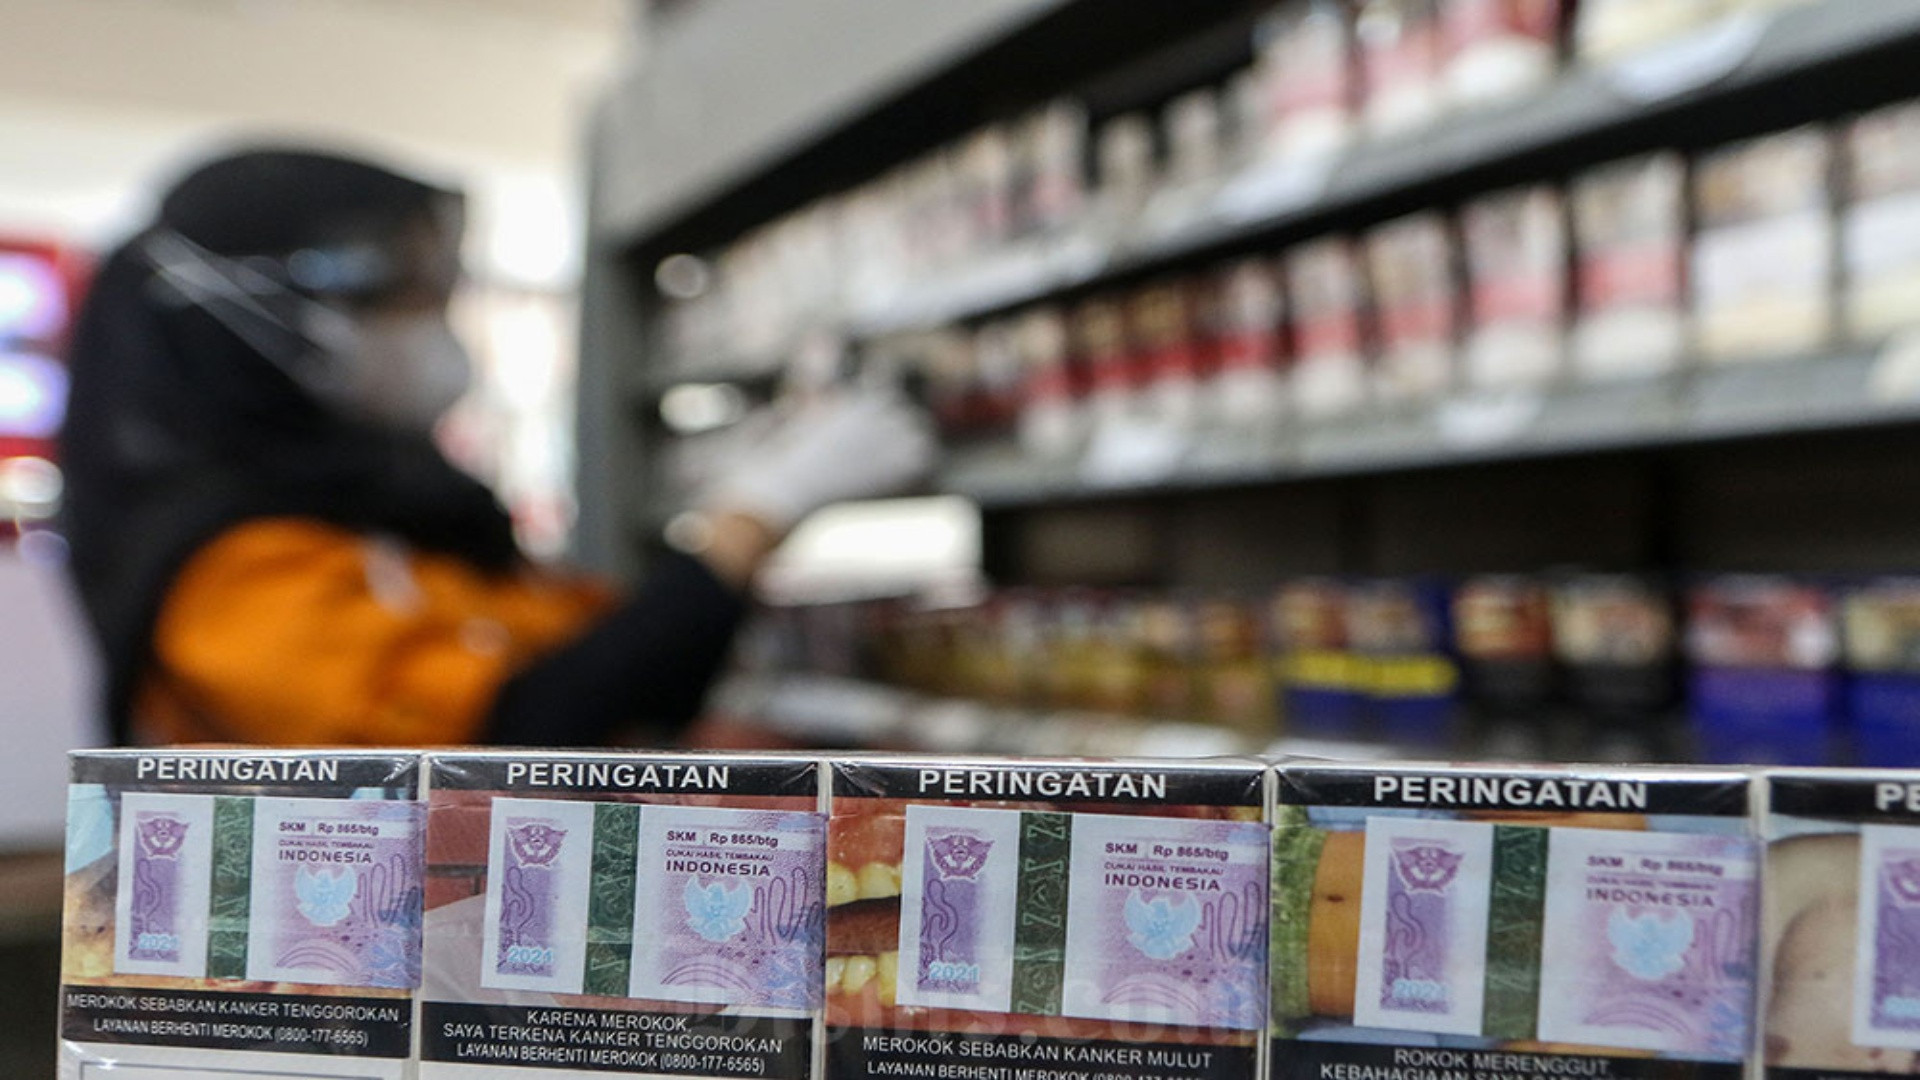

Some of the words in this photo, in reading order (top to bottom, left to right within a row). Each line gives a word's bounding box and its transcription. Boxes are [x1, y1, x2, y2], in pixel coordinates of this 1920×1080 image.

[137, 758, 339, 781] PERINGATAN
[507, 763, 730, 789] PERINGATAN
[918, 769, 1167, 799] PERINGATAN
[1374, 775, 1648, 809] PERINGATAN
[279, 822, 306, 832] SKM
[318, 822, 334, 834] Rp
[666, 830, 696, 841] SKM
[710, 832, 728, 845] Rp
[731, 833, 779, 848] 865/btg
[279, 849, 372, 863] INDONESIA
[1105, 842, 1138, 854] SKM
[1153, 844, 1173, 858] Rp
[1177, 846, 1229, 862] 865/btg
[666, 860, 770, 876] INDONESIA
[1105, 873, 1220, 891] INDONESIA
[1587, 888, 1714, 907] INDONESIA
[508, 946, 553, 964] 2021
[929, 961, 980, 983] 2021
[67, 993, 137, 1010] MEROKOK
[139, 997, 216, 1013] SEBABKAN
[218, 1000, 279, 1016] KANKER
[283, 1003, 399, 1022] TENGGOROKAN
[527, 1010, 598, 1028] KARENA
[94, 1018, 149, 1033] LAYANAN
[151, 1020, 210, 1037] BERHENTI
[212, 1023, 273, 1040] MEROKOK
[274, 1026, 369, 1047] (0800-177-6565)
[443, 1023, 485, 1039] SAYA
[489, 1024, 566, 1044] TERKENA
[570, 1029, 640, 1047] KANKER
[645, 1033, 783, 1054] TENGGOROKAN
[457, 1043, 518, 1059] LAYANAN
[520, 1045, 588, 1063] BERHENTI
[590, 1048, 657, 1067] MEROKOK
[660, 1052, 765, 1075] (0800-177-6565)
[863, 1036, 953, 1055] MEROKOK
[959, 1041, 1059, 1061] SEBABKAN
[1063, 1046, 1142, 1066] KANKER
[1147, 1050, 1213, 1069] MULUT
[1394, 1048, 1468, 1069] ROKOK
[1473, 1053, 1611, 1077] MERENGGUT
[867, 1061, 935, 1077] LAYANAN
[938, 1064, 1012, 1080] BERHENTI
